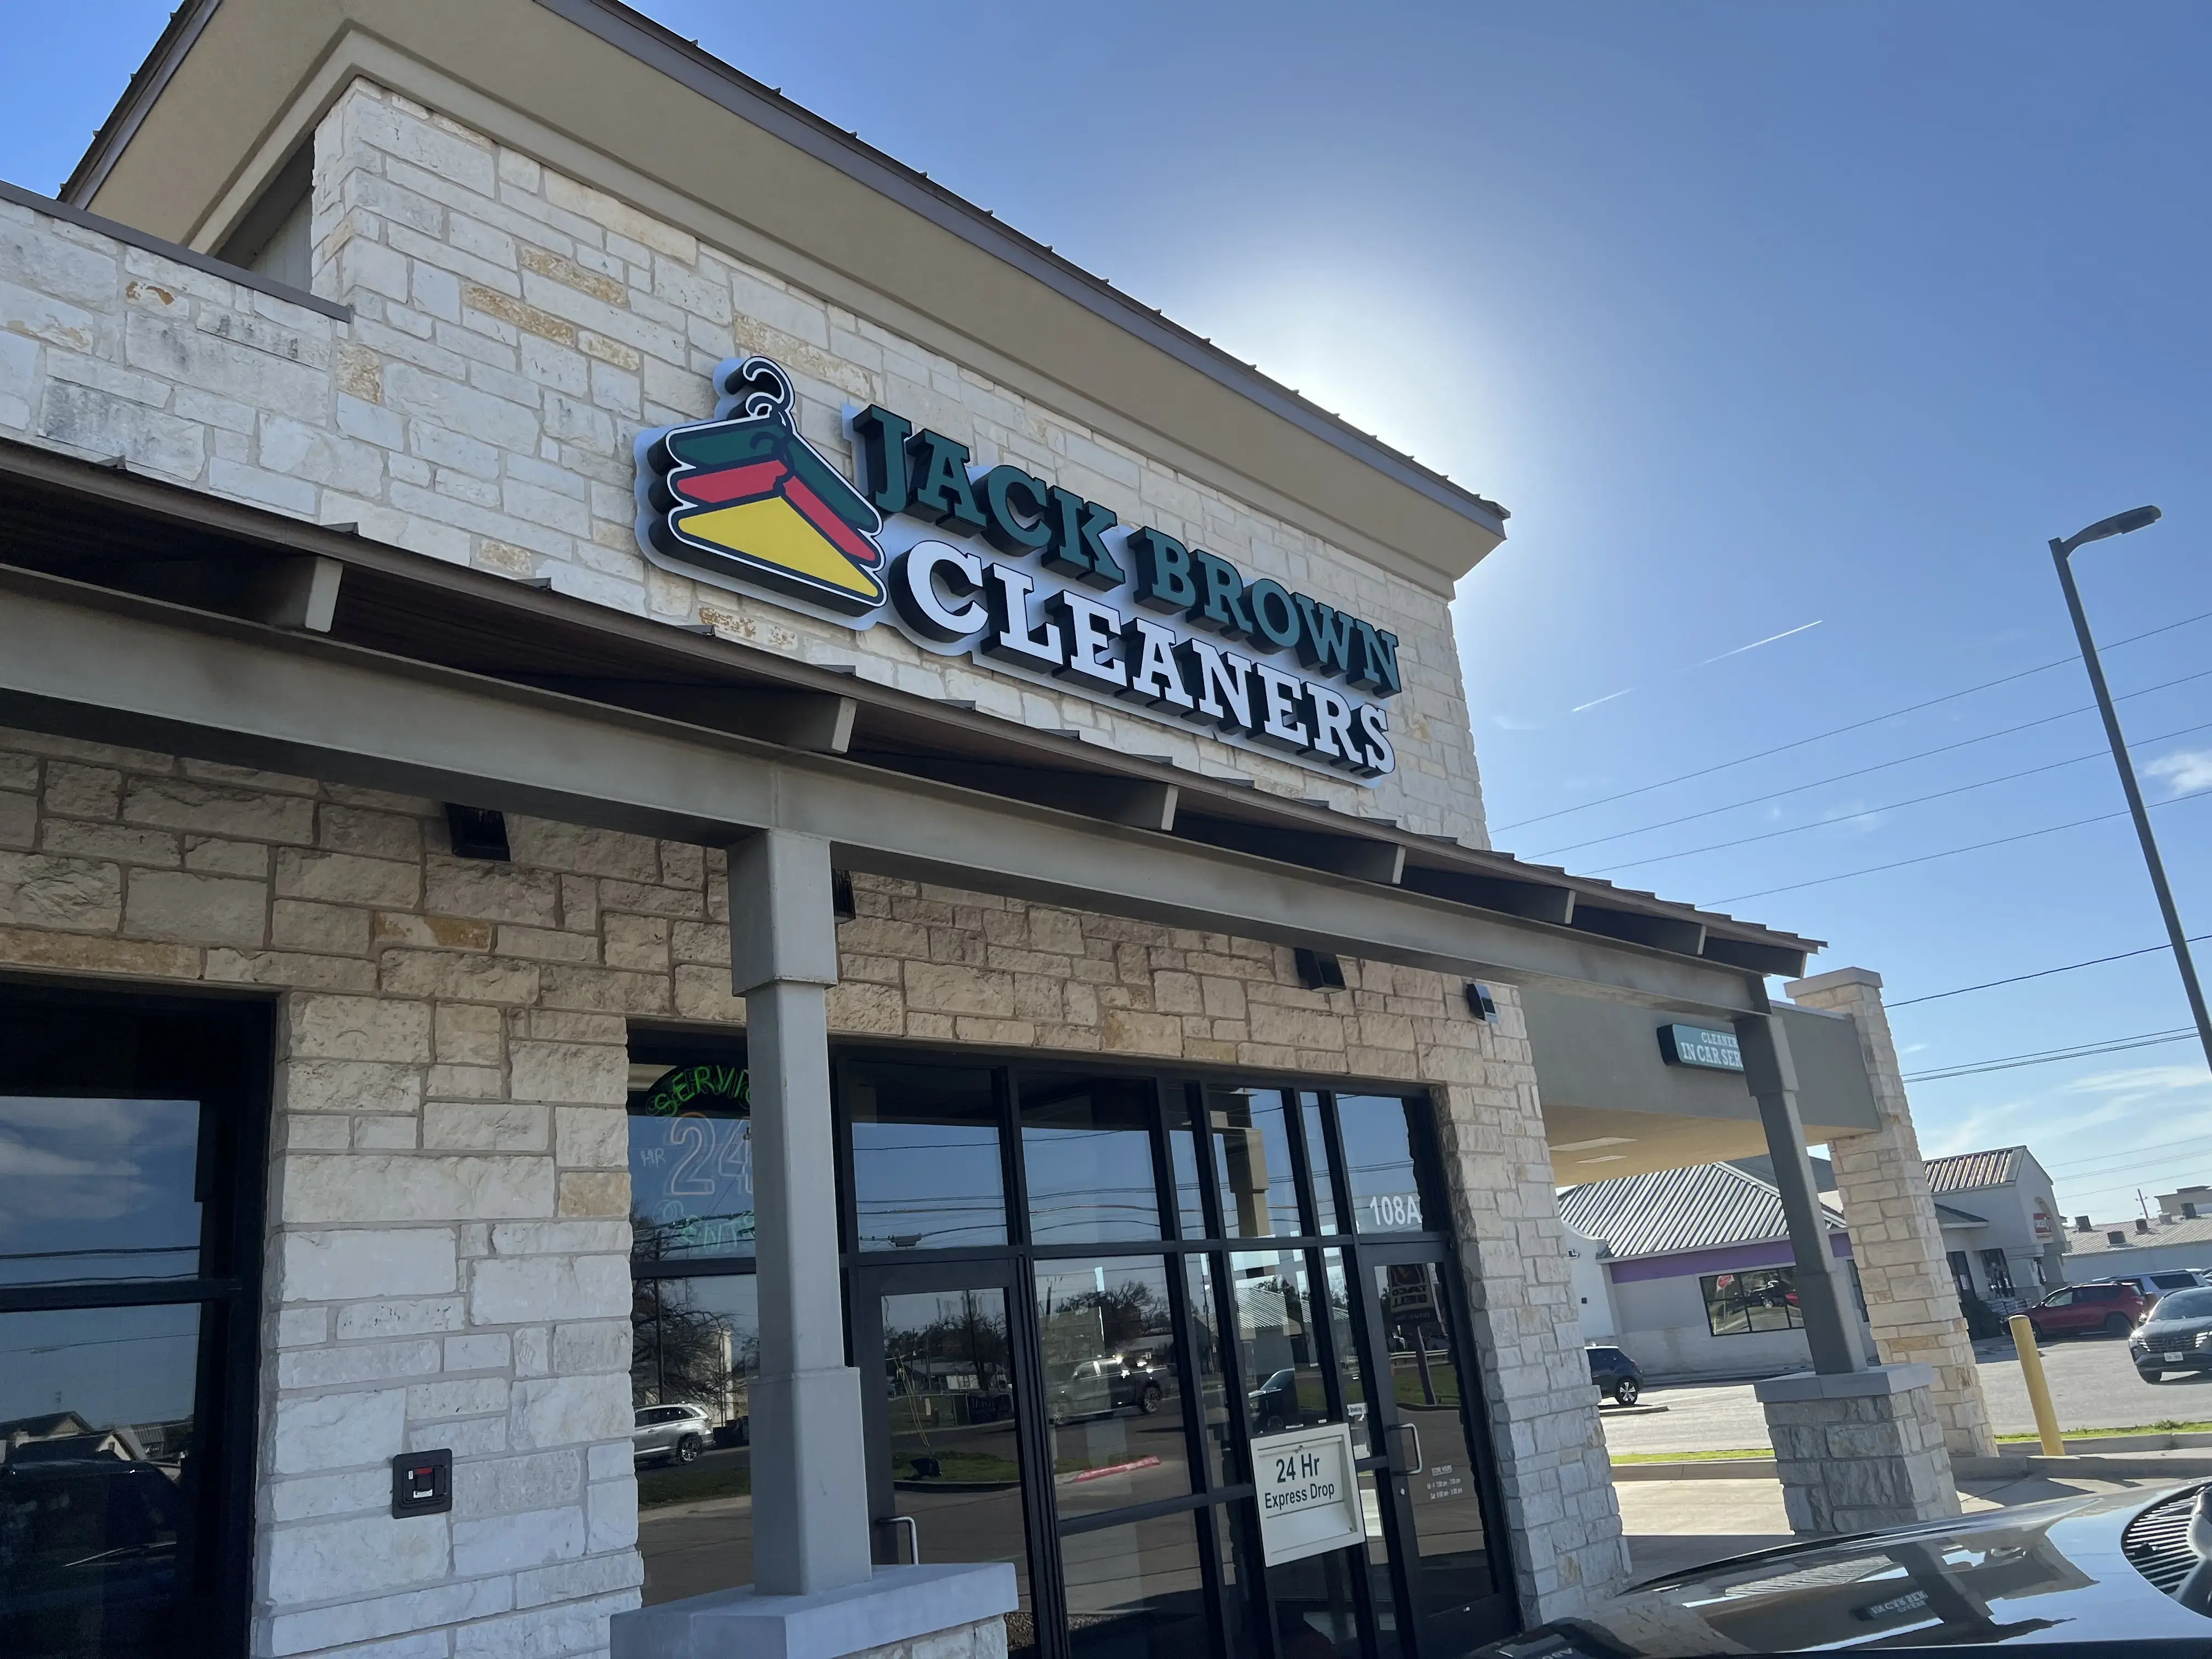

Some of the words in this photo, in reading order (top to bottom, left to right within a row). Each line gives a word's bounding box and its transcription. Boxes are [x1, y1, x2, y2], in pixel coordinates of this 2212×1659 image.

[864, 404, 1125, 591] JACK
[1135, 526, 1401, 698] BROWN
[902, 540, 1395, 776] CLEANERS
[1680, 1042, 1696, 1061] IN
[1697, 1045, 1722, 1065] CAR
[1721, 1049, 1743, 1068] SER
[1701, 1032, 1739, 1048] CLEANER
[1370, 1195, 1422, 1226] 108A
[1276, 1457, 1296, 1483] 24
[1301, 1453, 1320, 1479] Hr
[1265, 1487, 1307, 1510] Express
[1310, 1483, 1334, 1499] Drop
